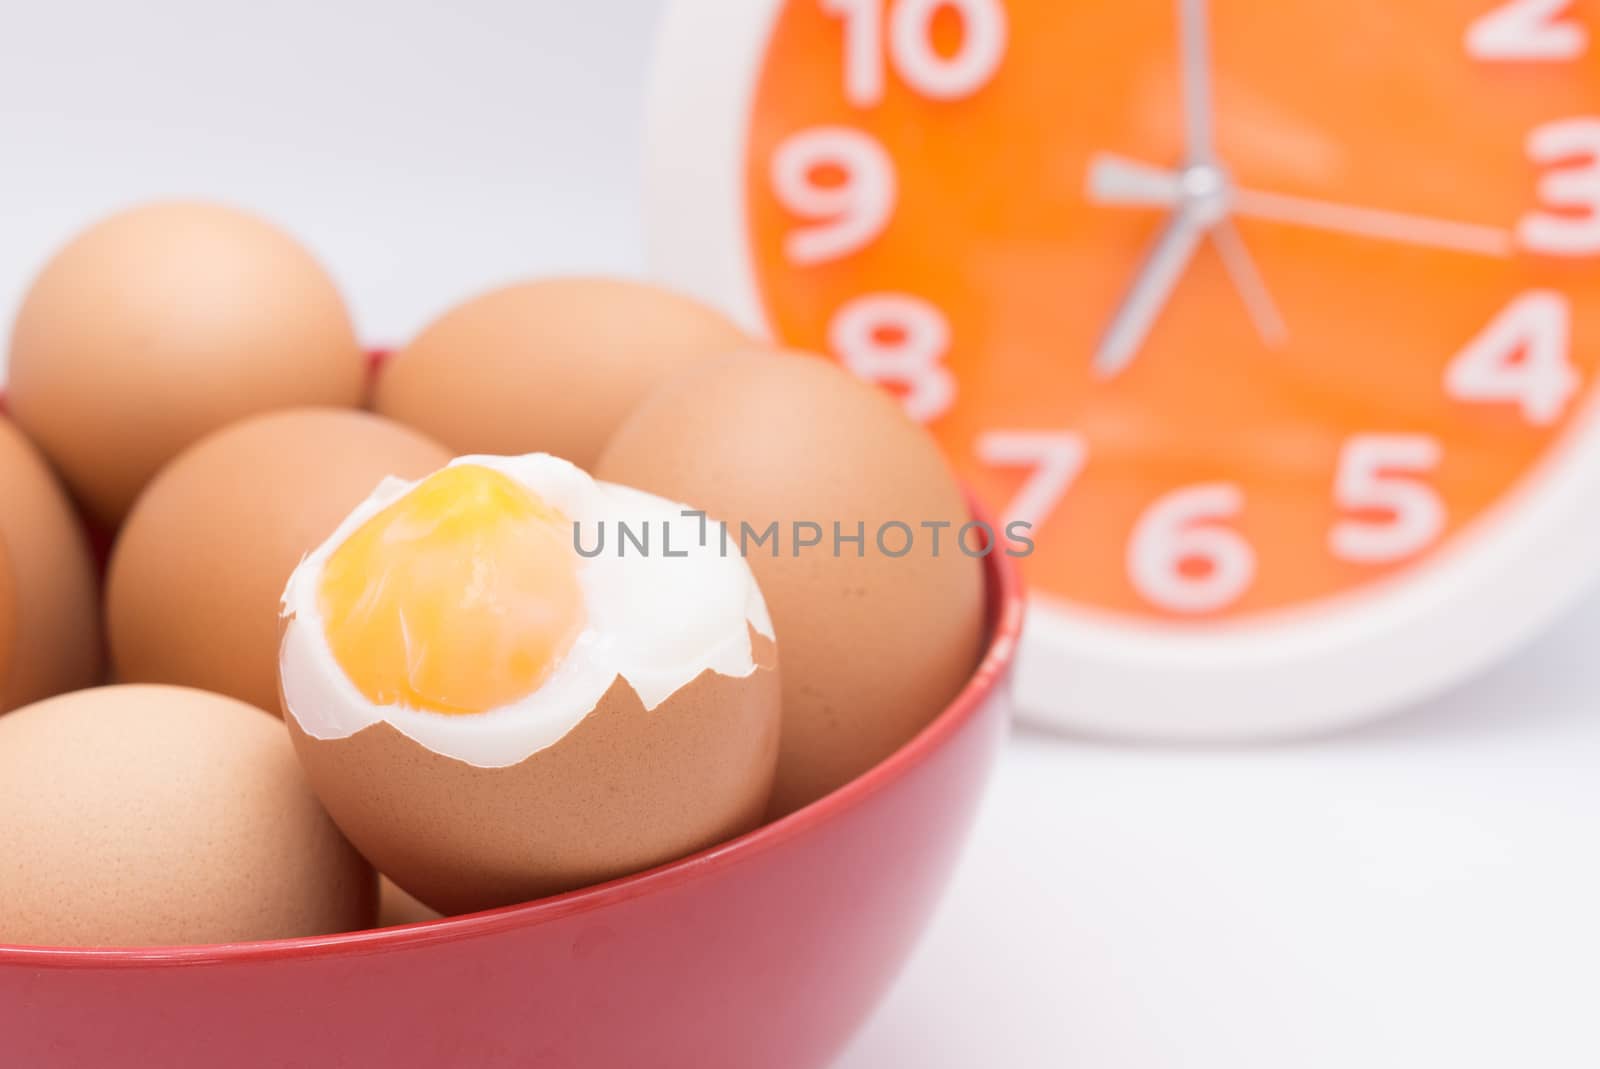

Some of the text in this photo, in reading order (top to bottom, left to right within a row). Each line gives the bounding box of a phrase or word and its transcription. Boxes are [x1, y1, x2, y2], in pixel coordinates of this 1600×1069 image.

[820, 0, 1007, 107] 10
[771, 127, 896, 264] 9
[1518, 117, 1600, 255] 3
[828, 293, 958, 423] 8
[1445, 290, 1580, 424] 4
[977, 432, 1086, 543] 7
[1127, 483, 1255, 612] 6
[1329, 434, 1446, 562] 5
